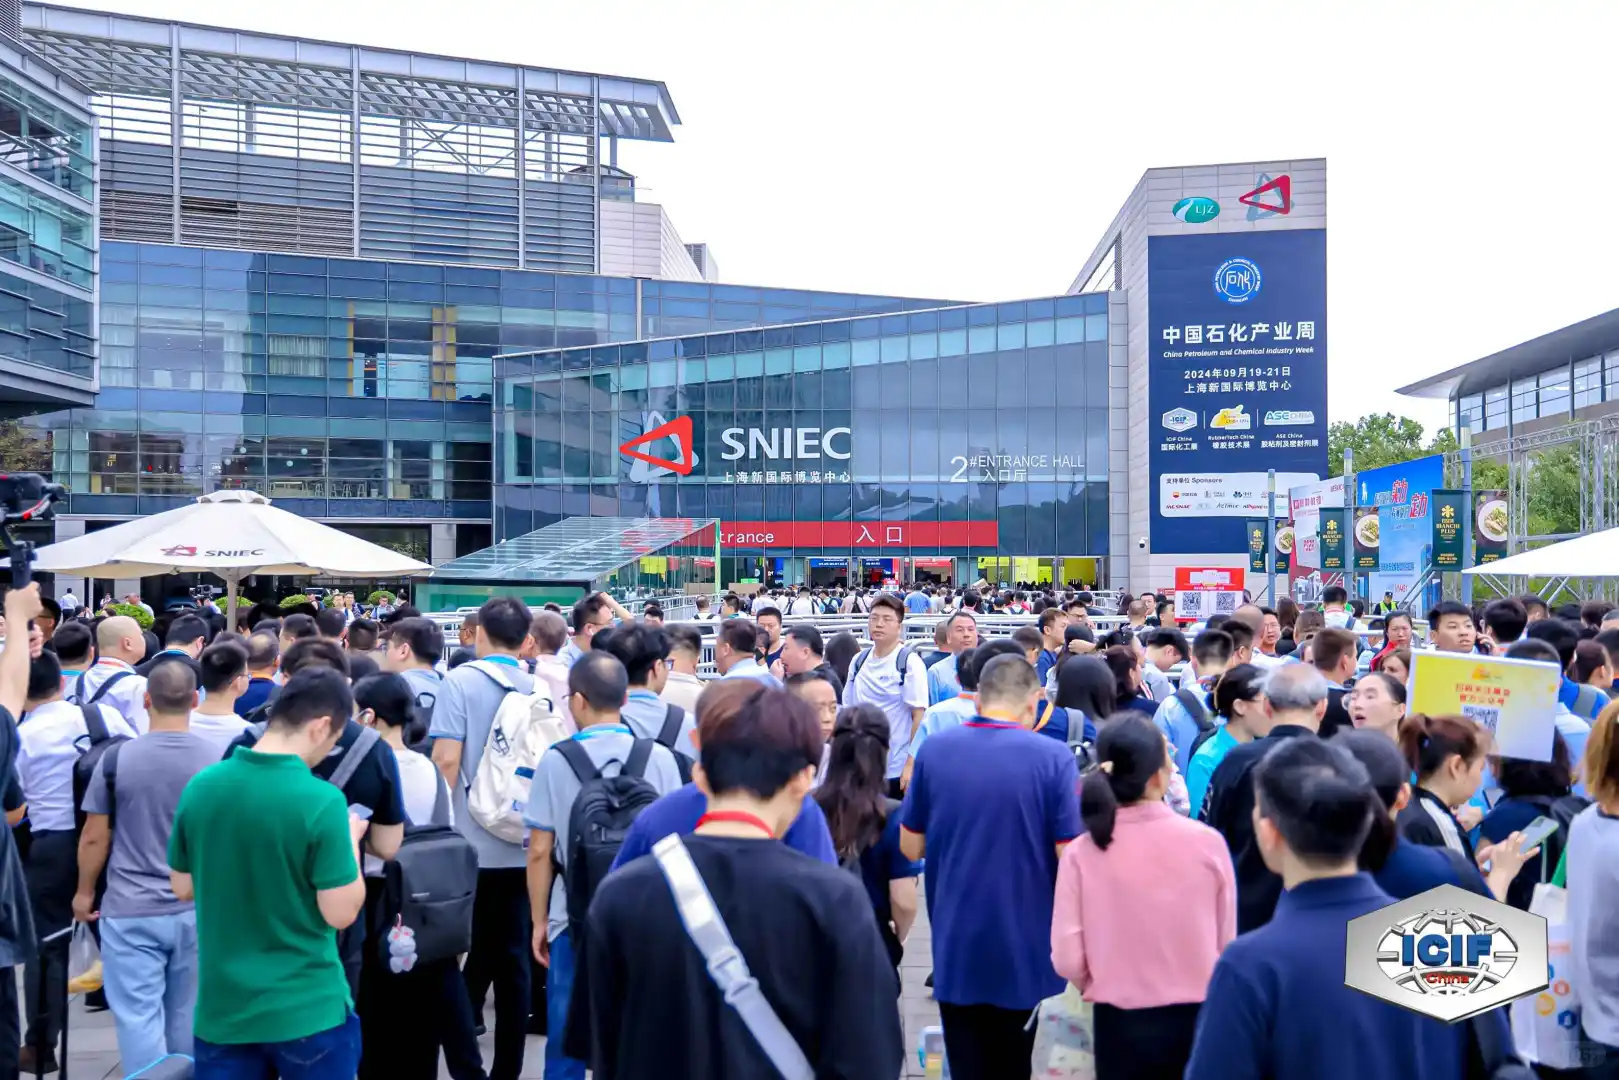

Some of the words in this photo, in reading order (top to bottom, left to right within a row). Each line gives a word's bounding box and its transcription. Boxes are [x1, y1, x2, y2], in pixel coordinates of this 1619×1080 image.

[1195, 205, 1215, 214] LJZ
[1162, 321, 1315, 345] 中国石化产业周
[1163, 350, 1183, 359] China
[1184, 349, 1218, 358] Petroleum
[1219, 348, 1232, 356] and
[1233, 347, 1265, 356] Chemical
[1266, 346, 1294, 356] Industry
[1295, 346, 1314, 354] Week
[1184, 366, 1291, 379] 2024年09月19-21日
[1184, 380, 1292, 394] 上海新国际博览中心
[721, 427, 851, 460] SNIEC
[1053, 454, 1085, 468] HALL
[722, 470, 851, 484] 上海新国际博览中心
[982, 469, 1027, 482] 入口厅
[1191, 477, 1223, 485] Sponsors
[855, 525, 903, 544] 入口
[204, 548, 266, 557] SNIEC
